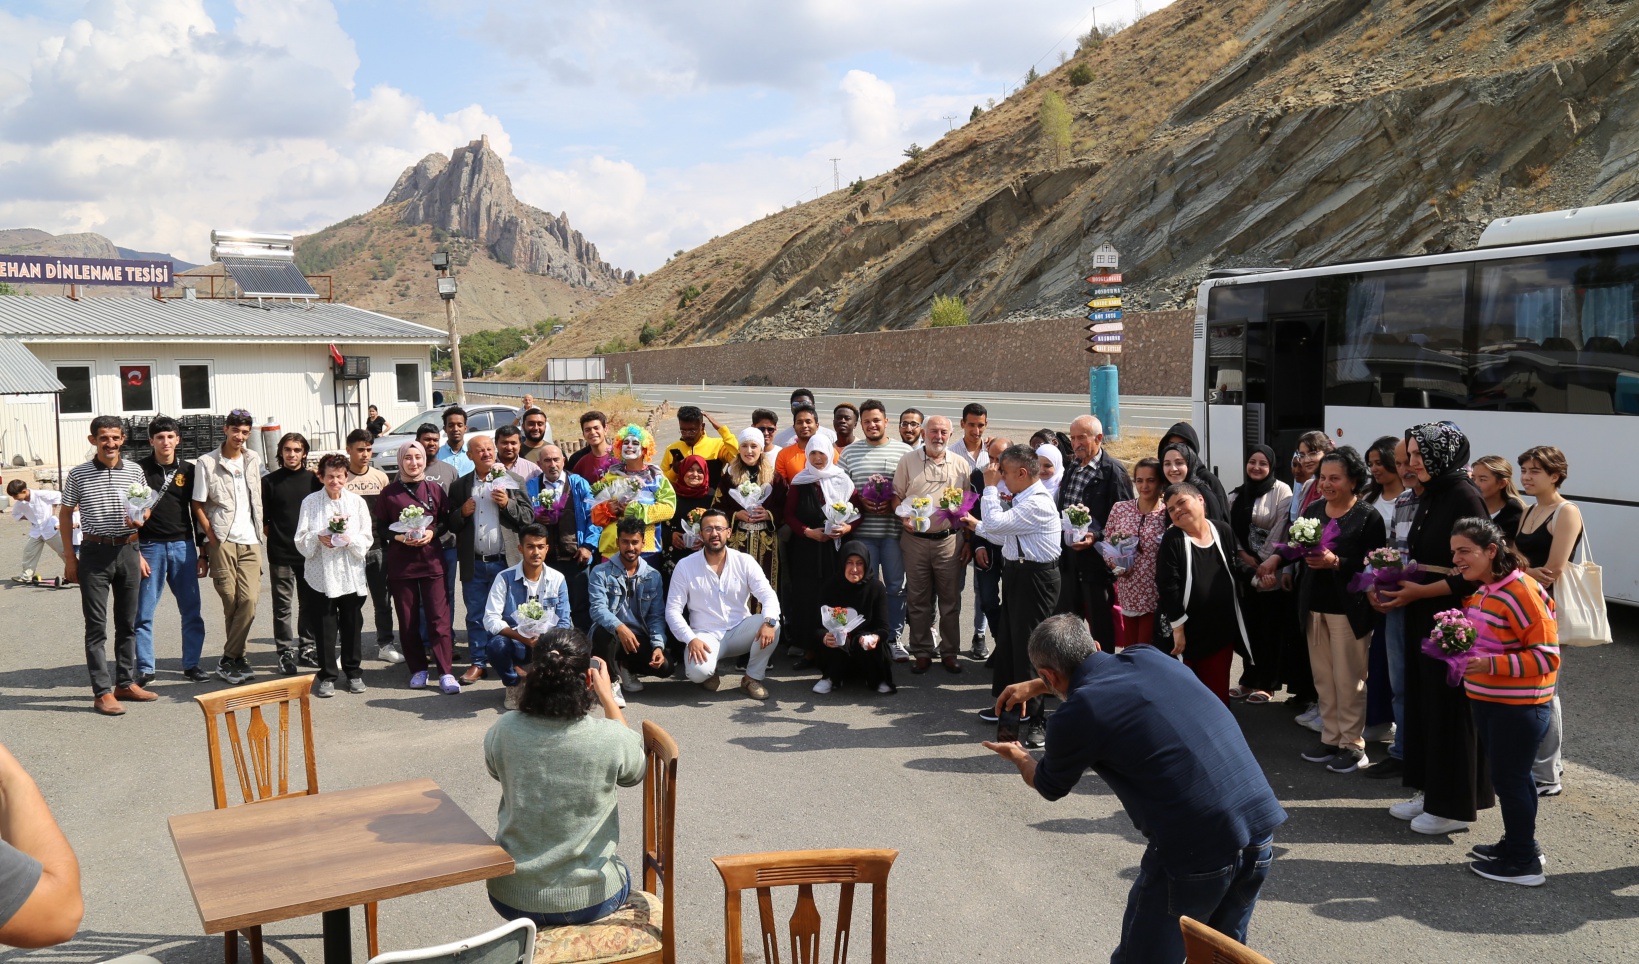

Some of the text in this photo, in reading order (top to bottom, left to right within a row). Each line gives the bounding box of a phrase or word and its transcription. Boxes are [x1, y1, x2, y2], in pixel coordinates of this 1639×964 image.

[45, 259, 123, 281] DİNLENME
[125, 264, 168, 283] TESİSİ
[347, 482, 380, 491] ONDON
